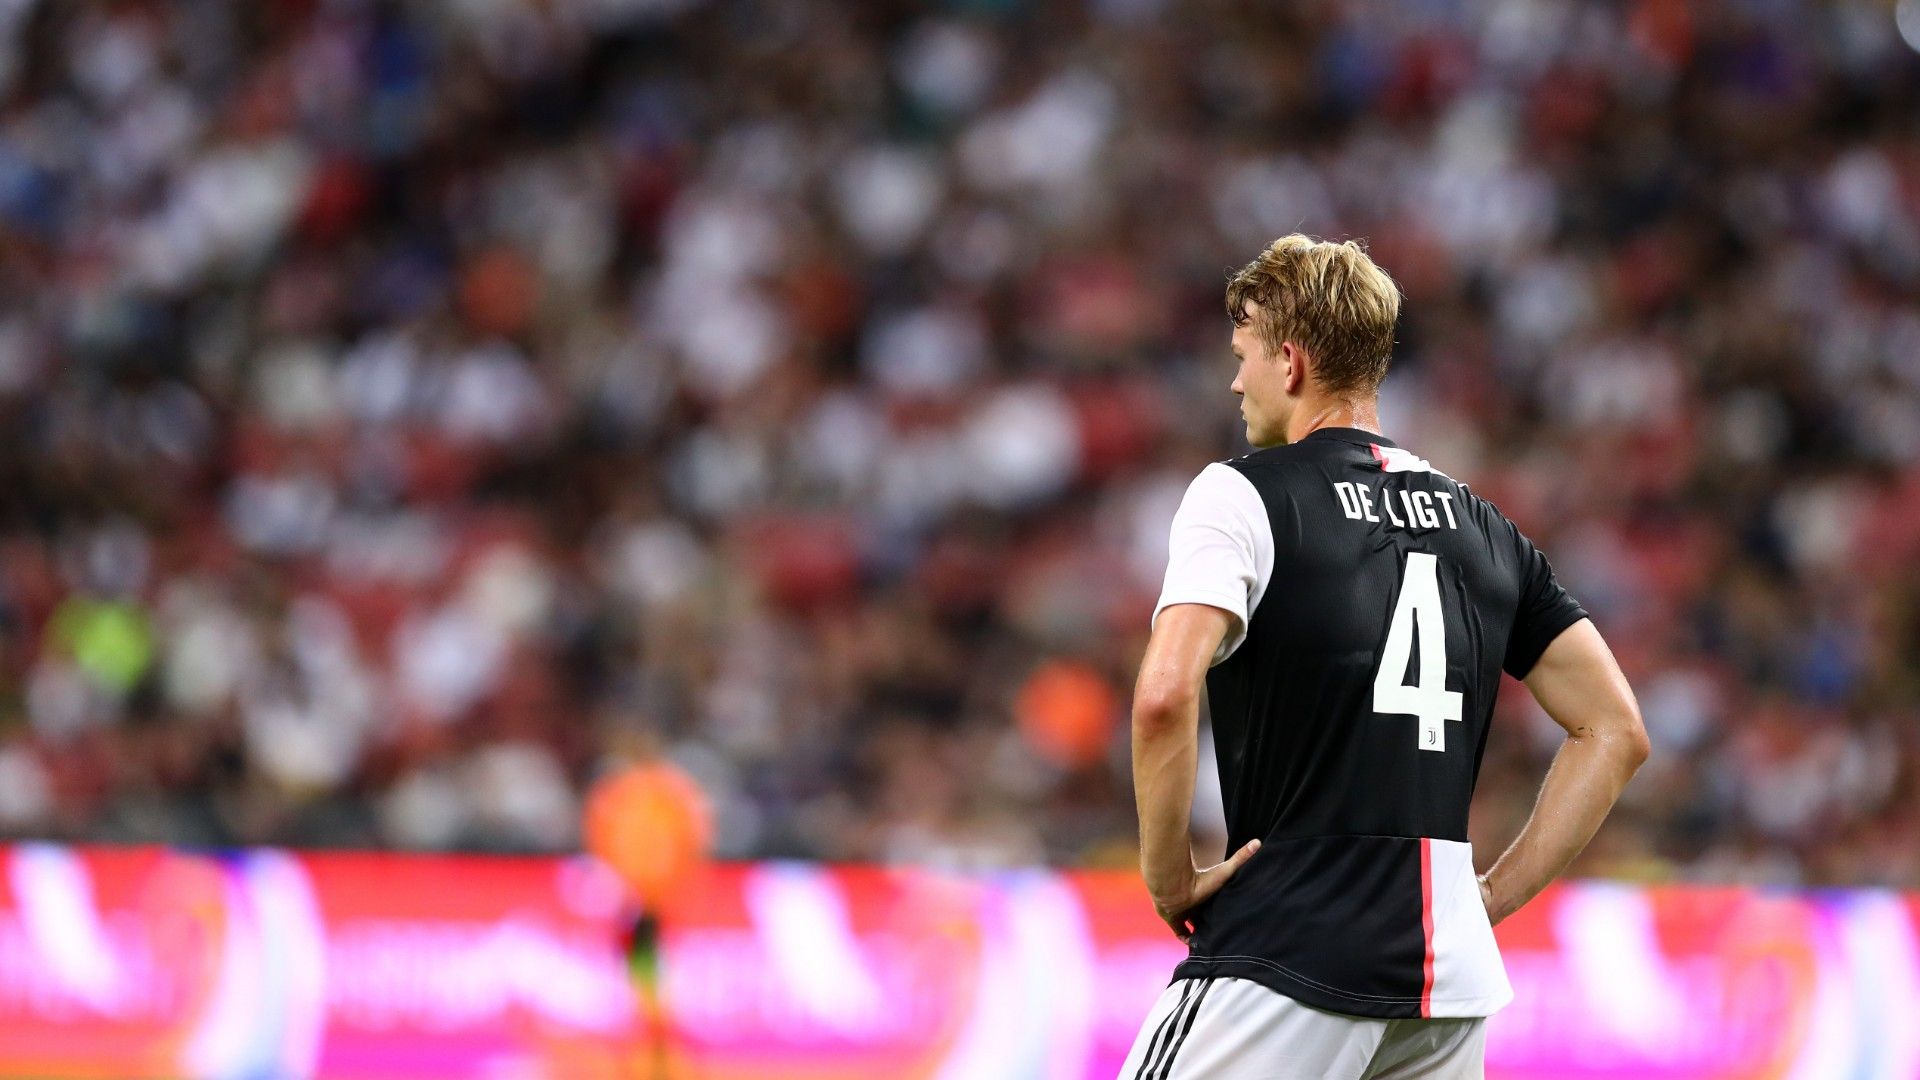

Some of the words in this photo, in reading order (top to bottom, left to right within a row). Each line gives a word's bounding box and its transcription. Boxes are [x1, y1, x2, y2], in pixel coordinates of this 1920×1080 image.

[1333, 481, 1380, 523] DE
[1382, 487, 1457, 530] LIGT
[1373, 552, 1464, 752] 4
